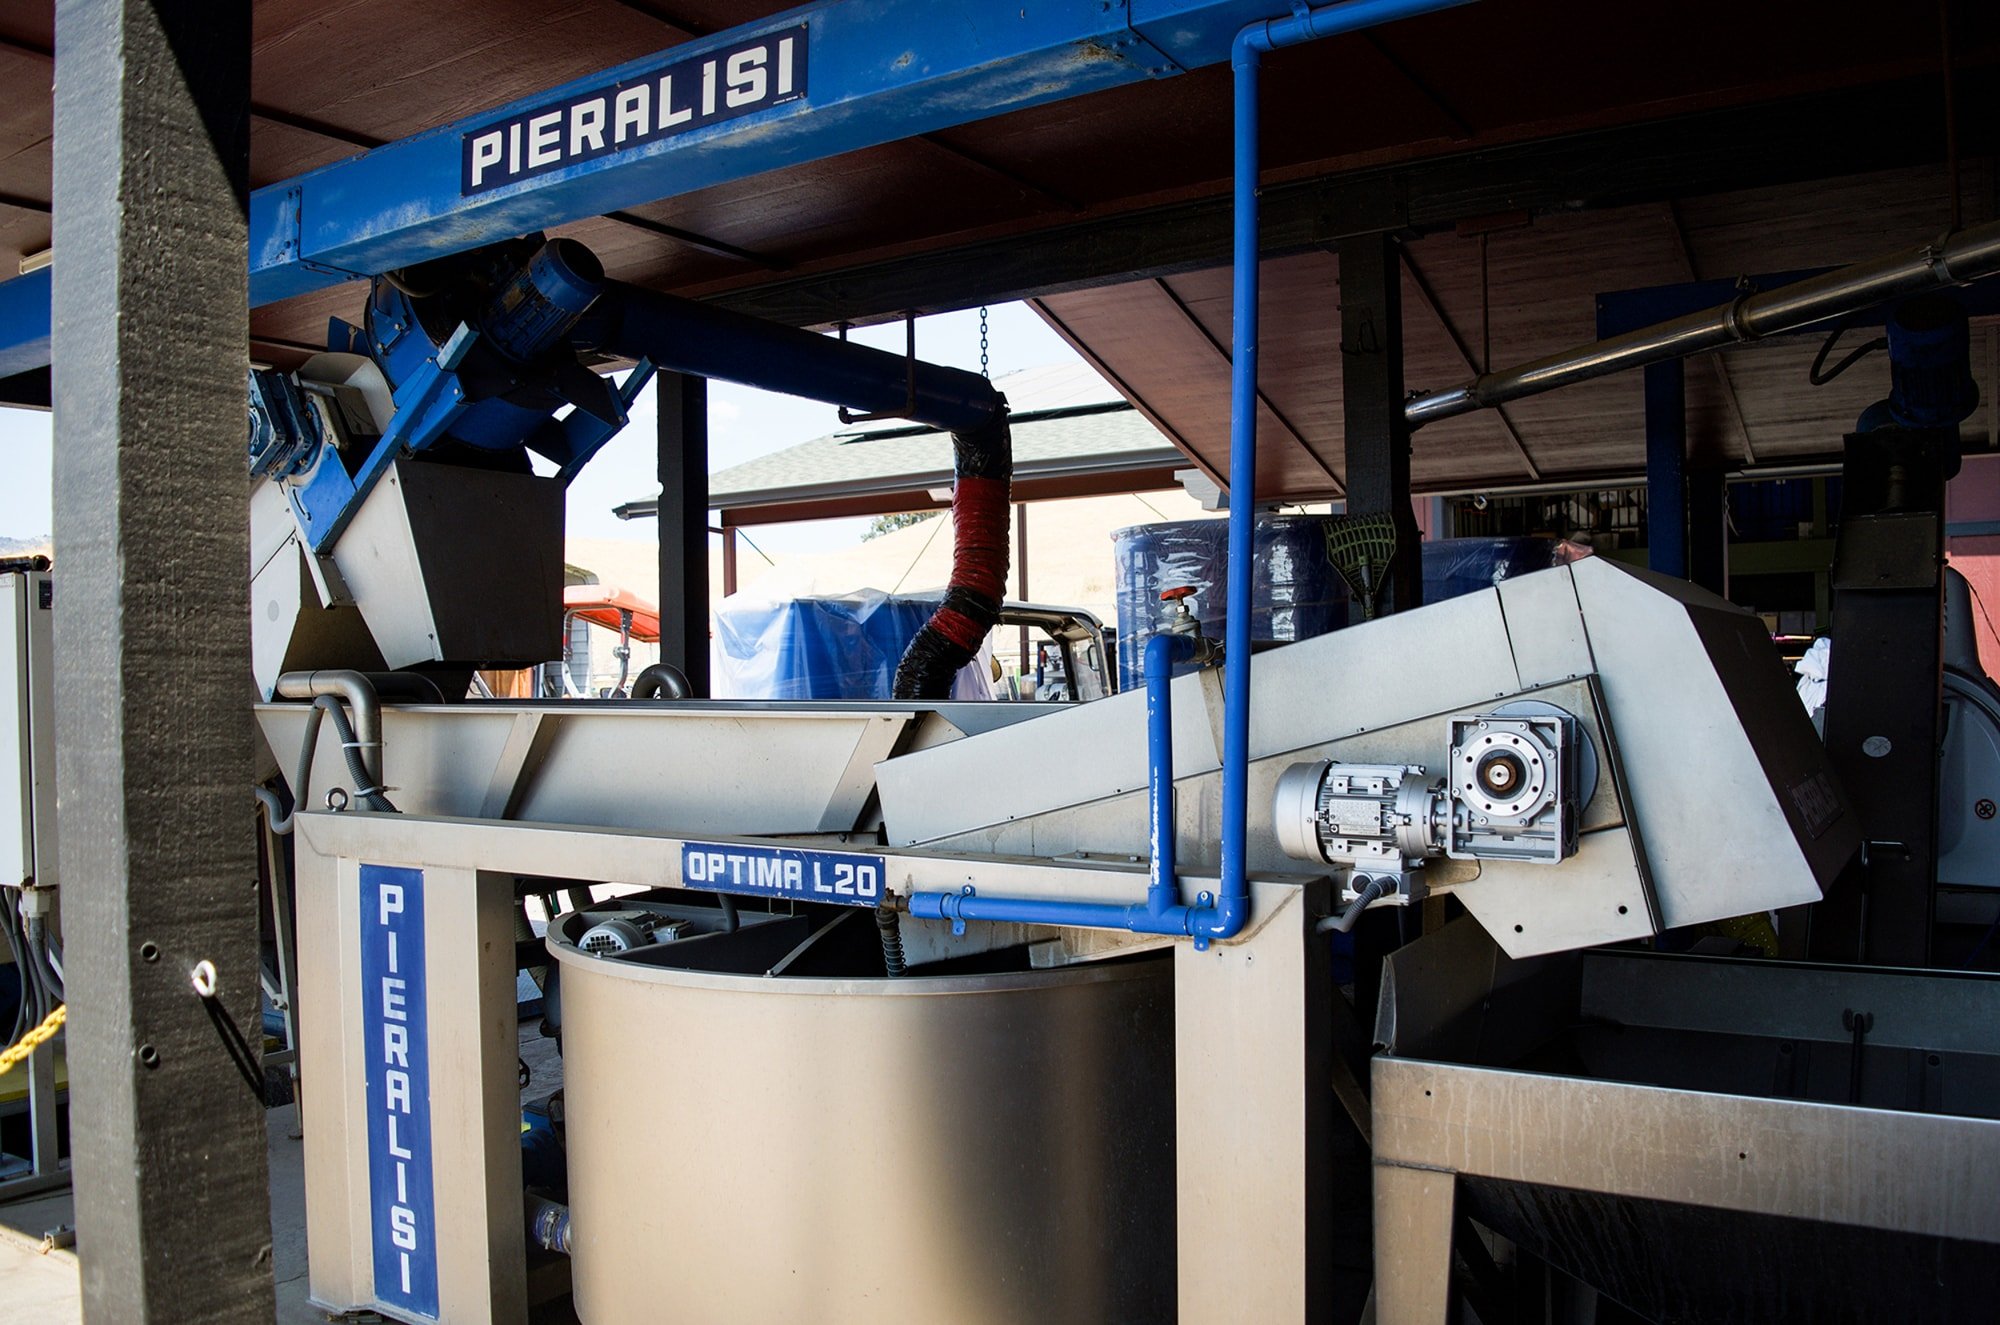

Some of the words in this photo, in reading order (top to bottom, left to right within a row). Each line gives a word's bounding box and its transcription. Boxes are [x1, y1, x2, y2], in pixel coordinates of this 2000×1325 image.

[472, 37, 793, 187] PIERALISI
[688, 852, 802, 890] OPTIMA
[813, 861, 877, 897] L20
[379, 883, 416, 1294] PIERALISI
